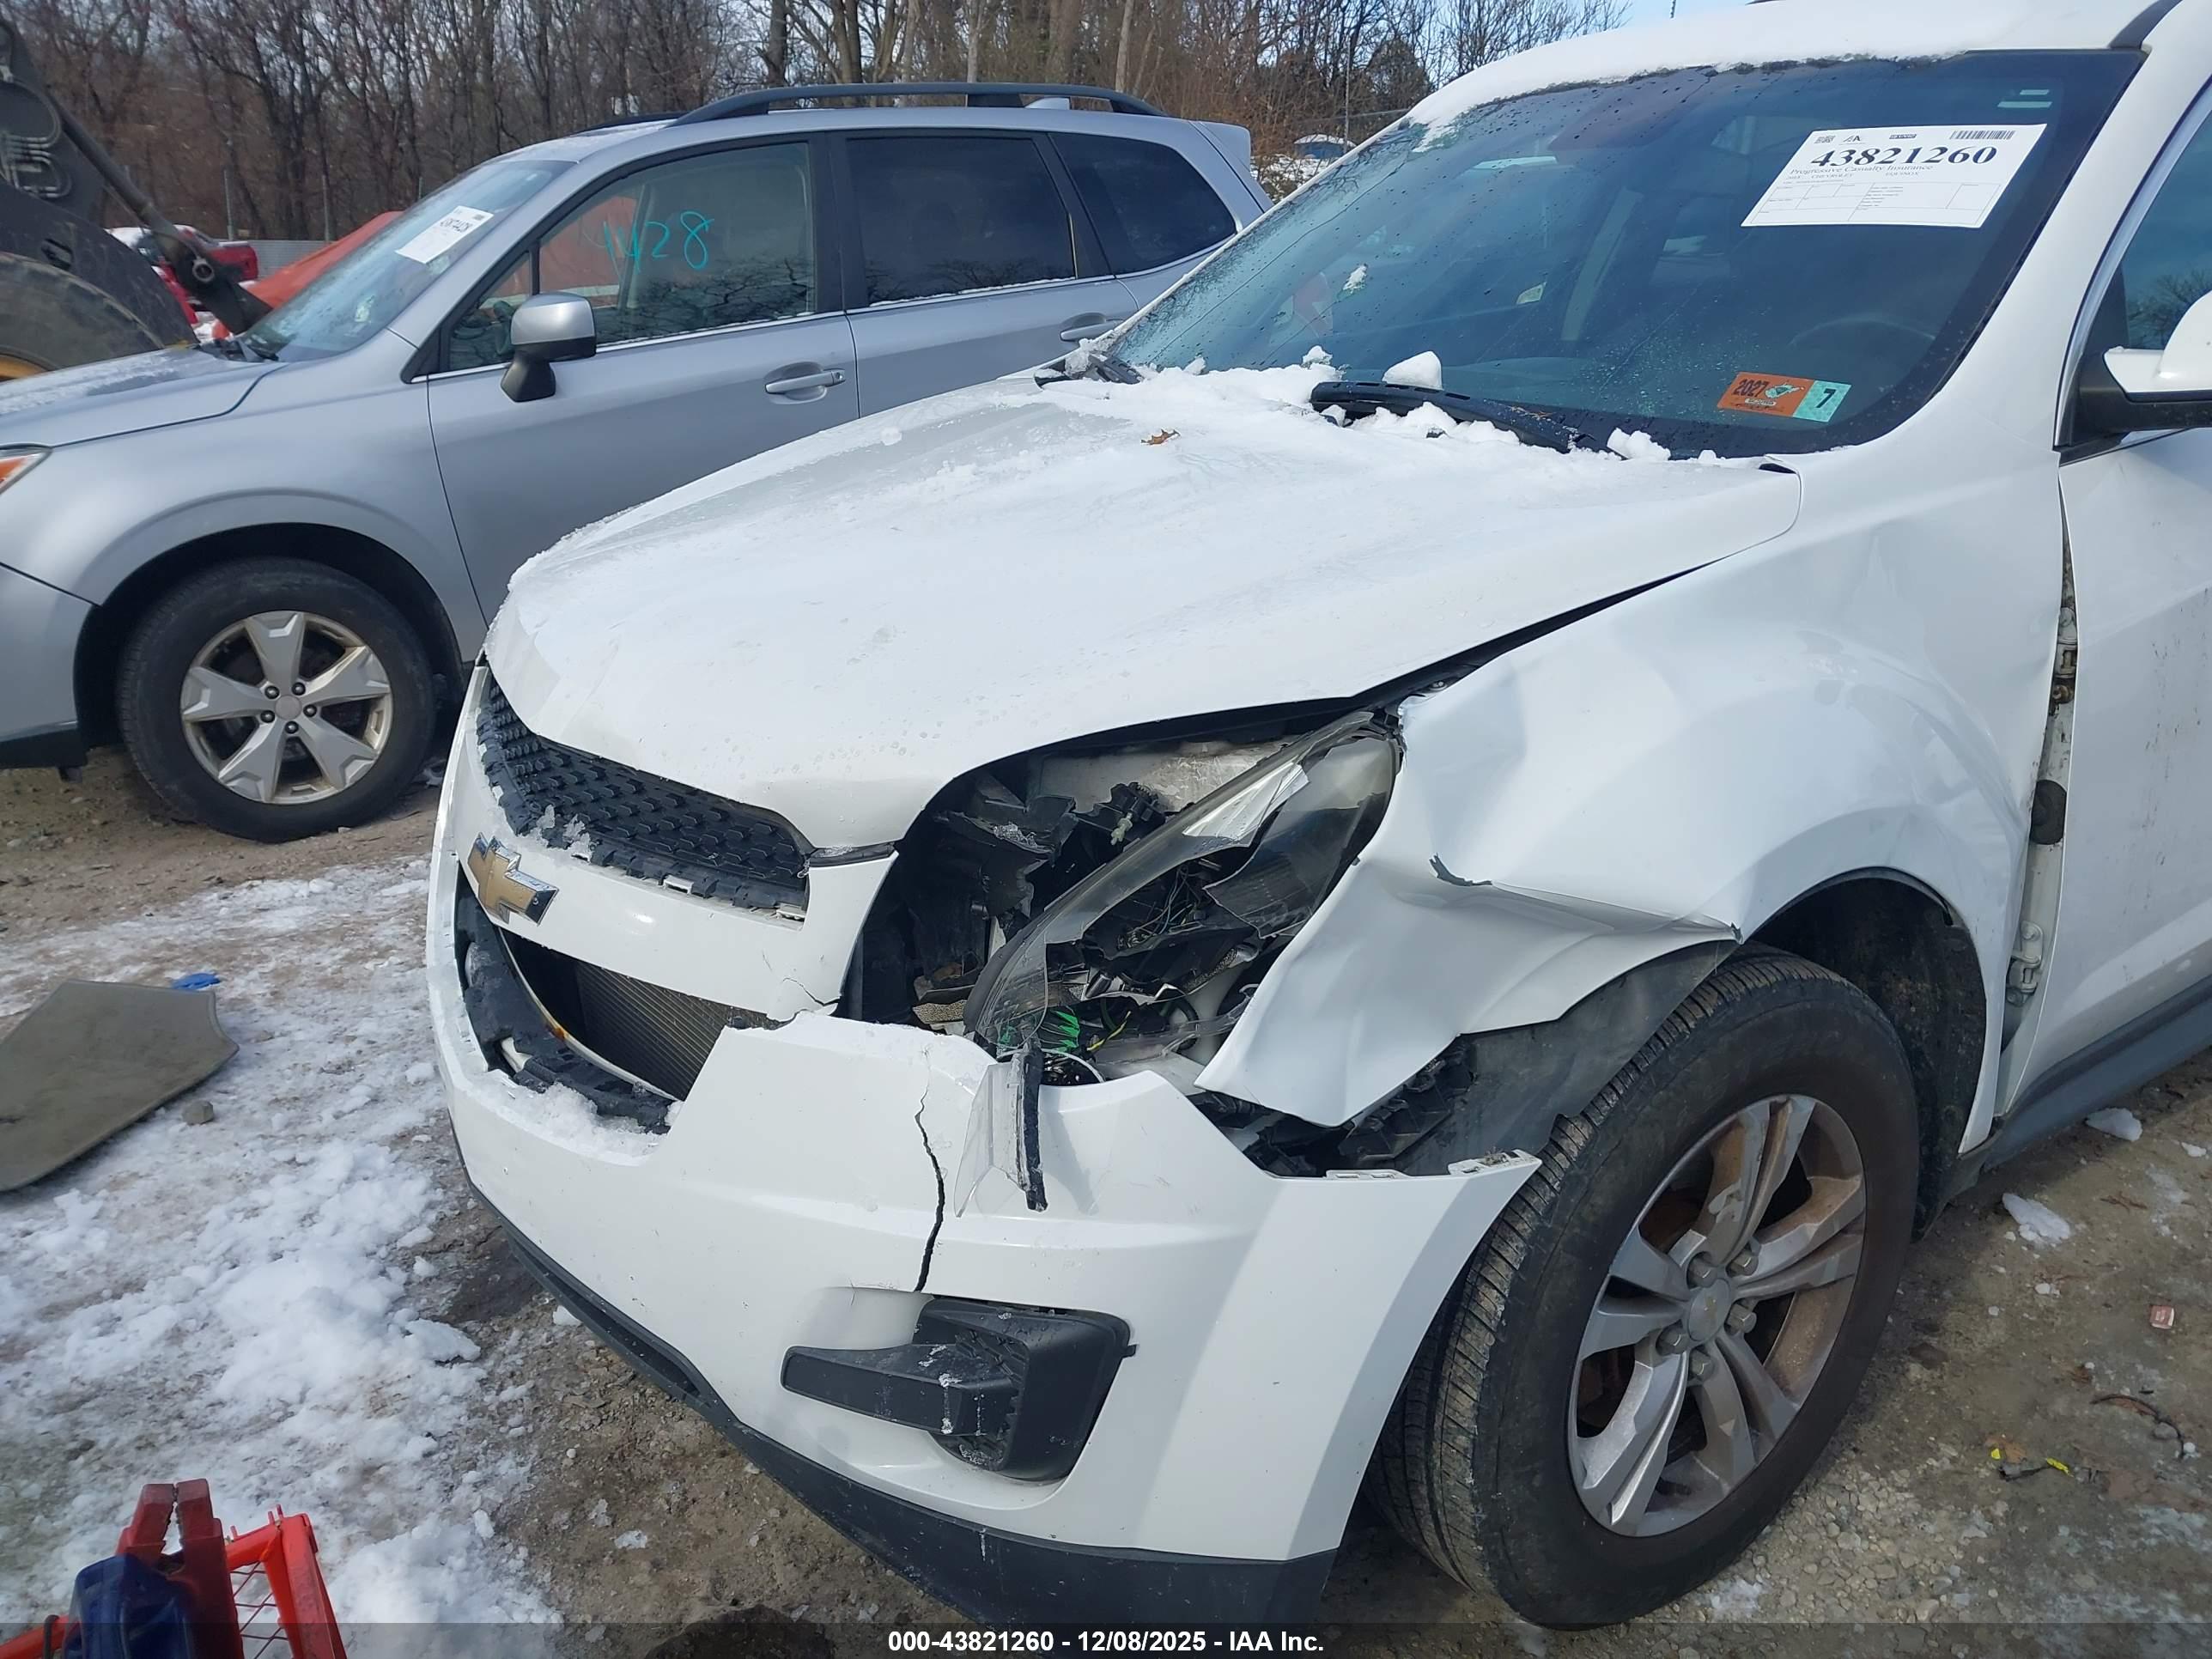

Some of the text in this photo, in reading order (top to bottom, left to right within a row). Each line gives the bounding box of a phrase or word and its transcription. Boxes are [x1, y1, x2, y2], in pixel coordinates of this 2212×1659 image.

[1810, 146, 1998, 167] 43821260
[1732, 378, 1771, 398] 2027
[1815, 387, 1837, 409] 7
